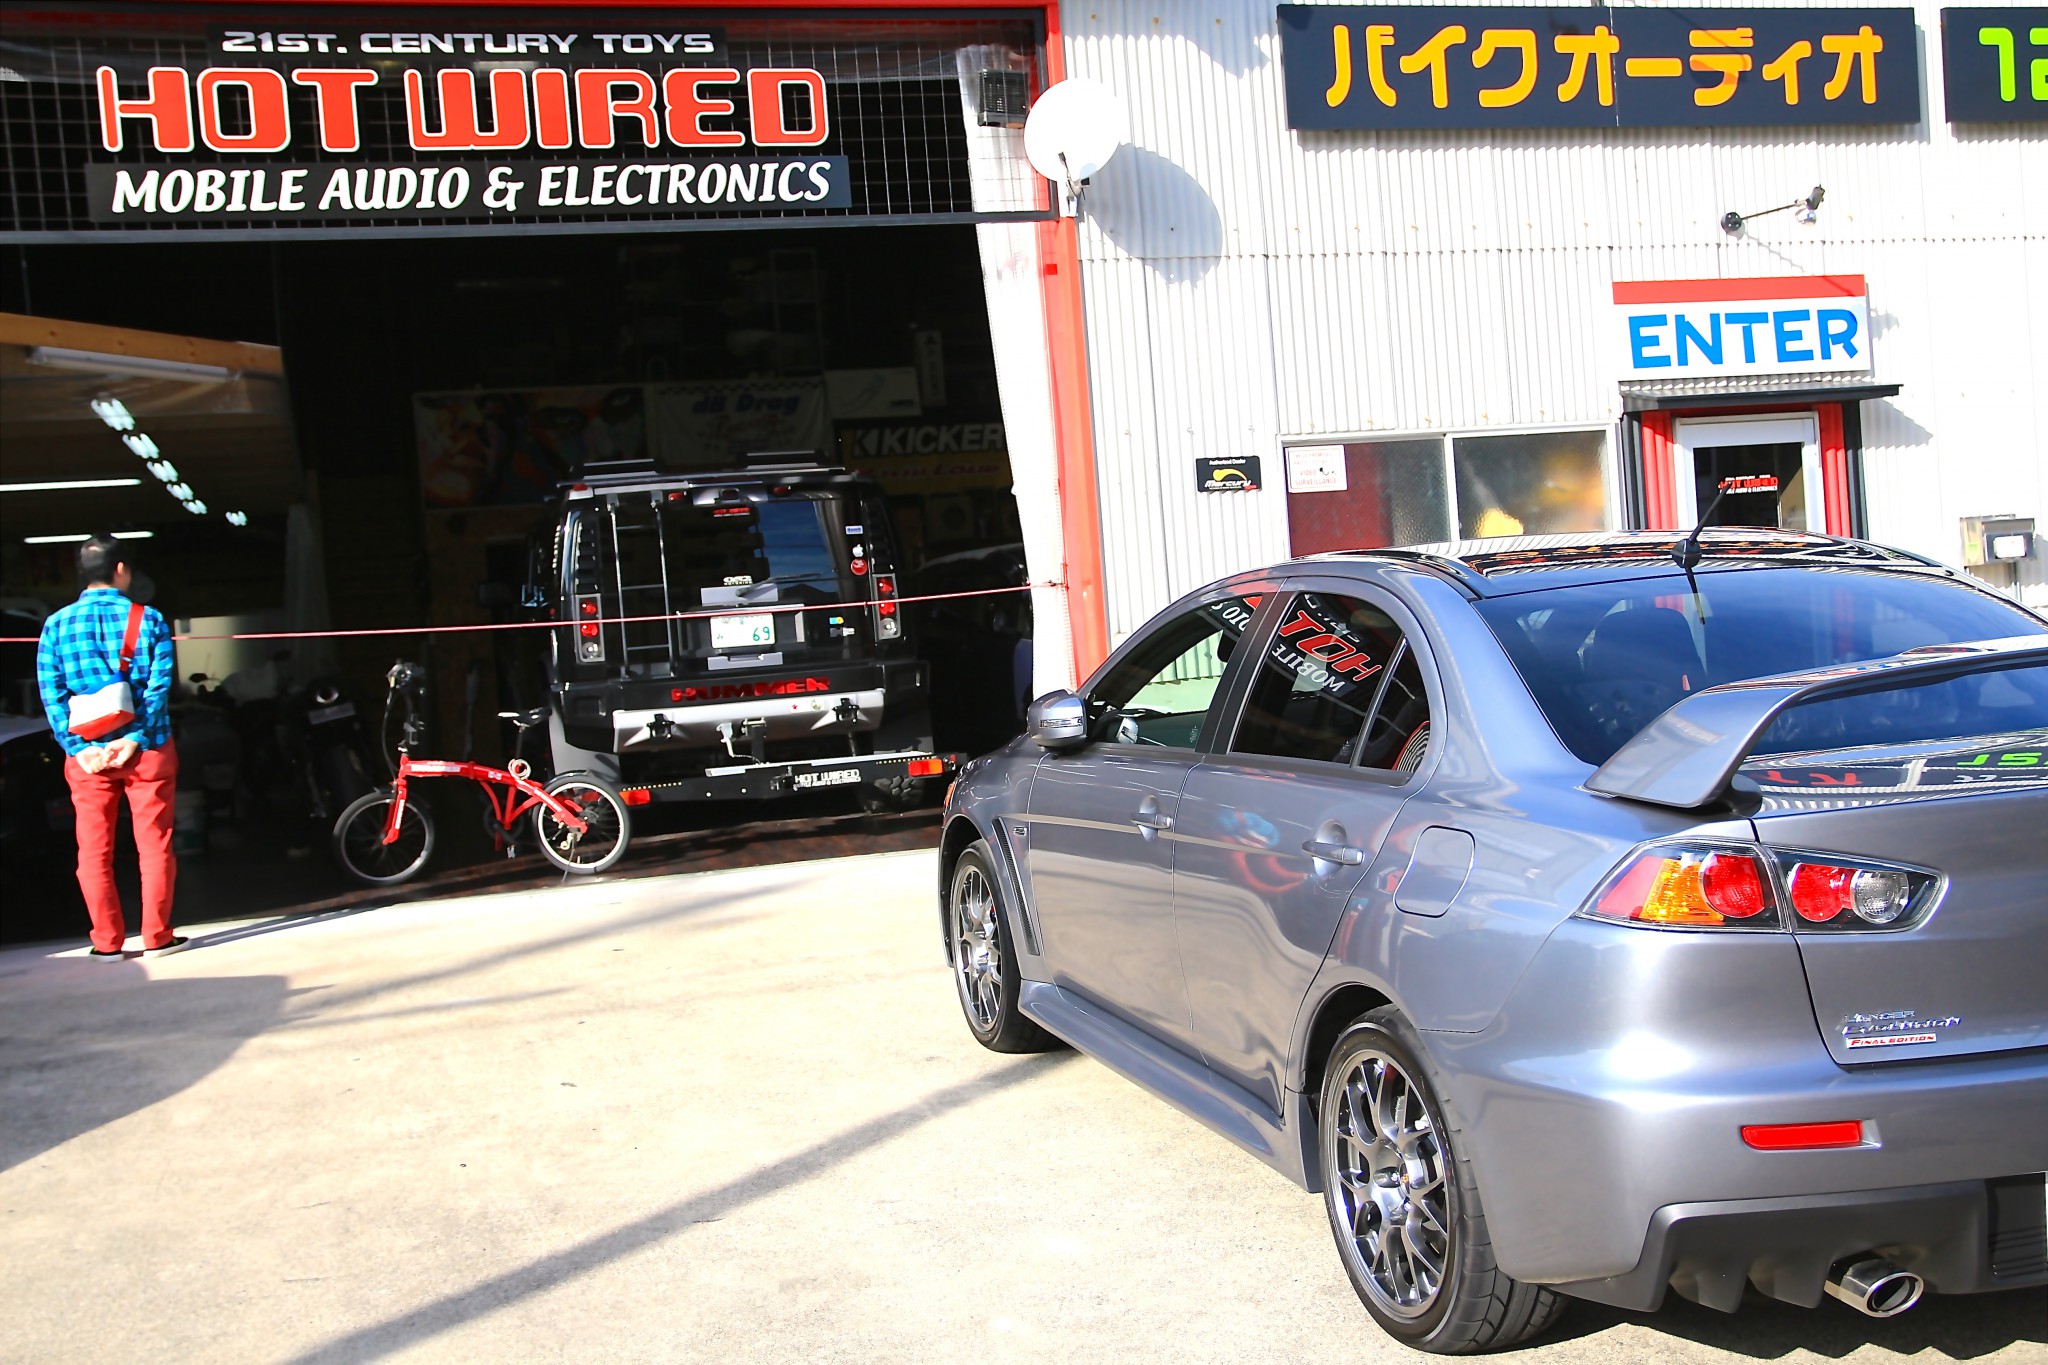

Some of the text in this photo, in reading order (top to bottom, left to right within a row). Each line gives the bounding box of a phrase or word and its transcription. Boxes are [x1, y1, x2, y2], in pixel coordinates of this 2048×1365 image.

[222, 31, 715, 53] 21ST. CENTURY TOYS
[1326, 25, 1884, 108] バイクオーディオ
[96, 66, 829, 152] HOT WIRED
[112, 161, 832, 213] MOBILE AUDIO & ELECTRONICS
[1628, 309, 1859, 369] ENTER
[880, 422, 1001, 456] KICKER
[671, 677, 830, 702] HUMMER
[794, 768, 860, 784] HOT WIRED
